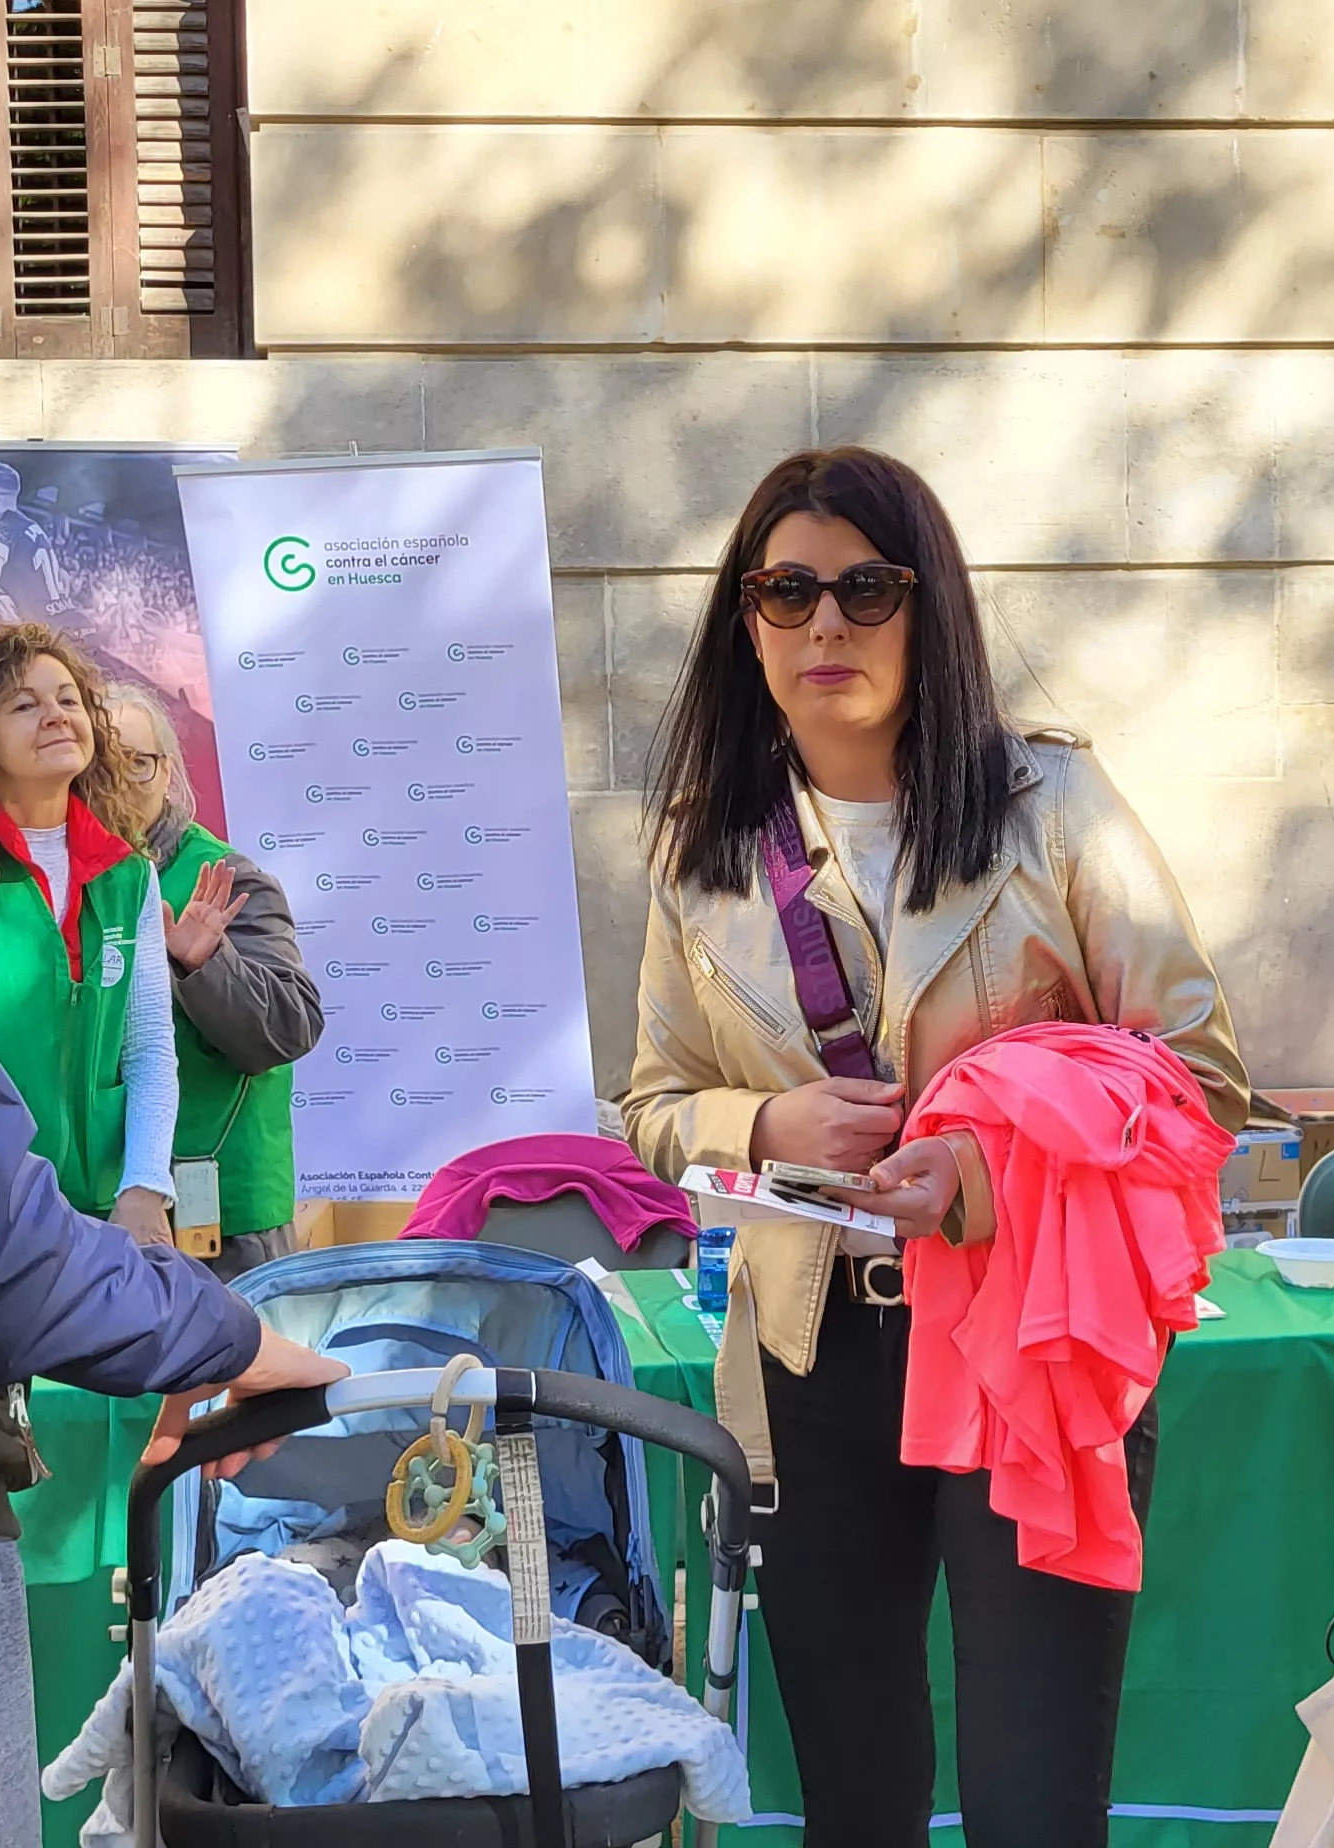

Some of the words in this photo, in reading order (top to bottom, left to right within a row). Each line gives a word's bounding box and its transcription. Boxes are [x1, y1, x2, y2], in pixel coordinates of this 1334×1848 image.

[323, 536, 399, 552] asociación
[403, 534, 469, 551] española
[325, 556, 371, 568] contra
[375, 554, 387, 567] el
[391, 553, 441, 566] cáncer
[327, 574, 345, 586] en
[348, 572, 402, 585] Huesca
[1258, 1149, 1281, 1182] L
[299, 1171, 356, 1182] Asociación
[358, 1170, 405, 1181] Española
[333, 1184, 346, 1193] de
[349, 1183, 357, 1193] la
[401, 1184, 408, 1192] 4
[411, 1183, 426, 1192] 22
